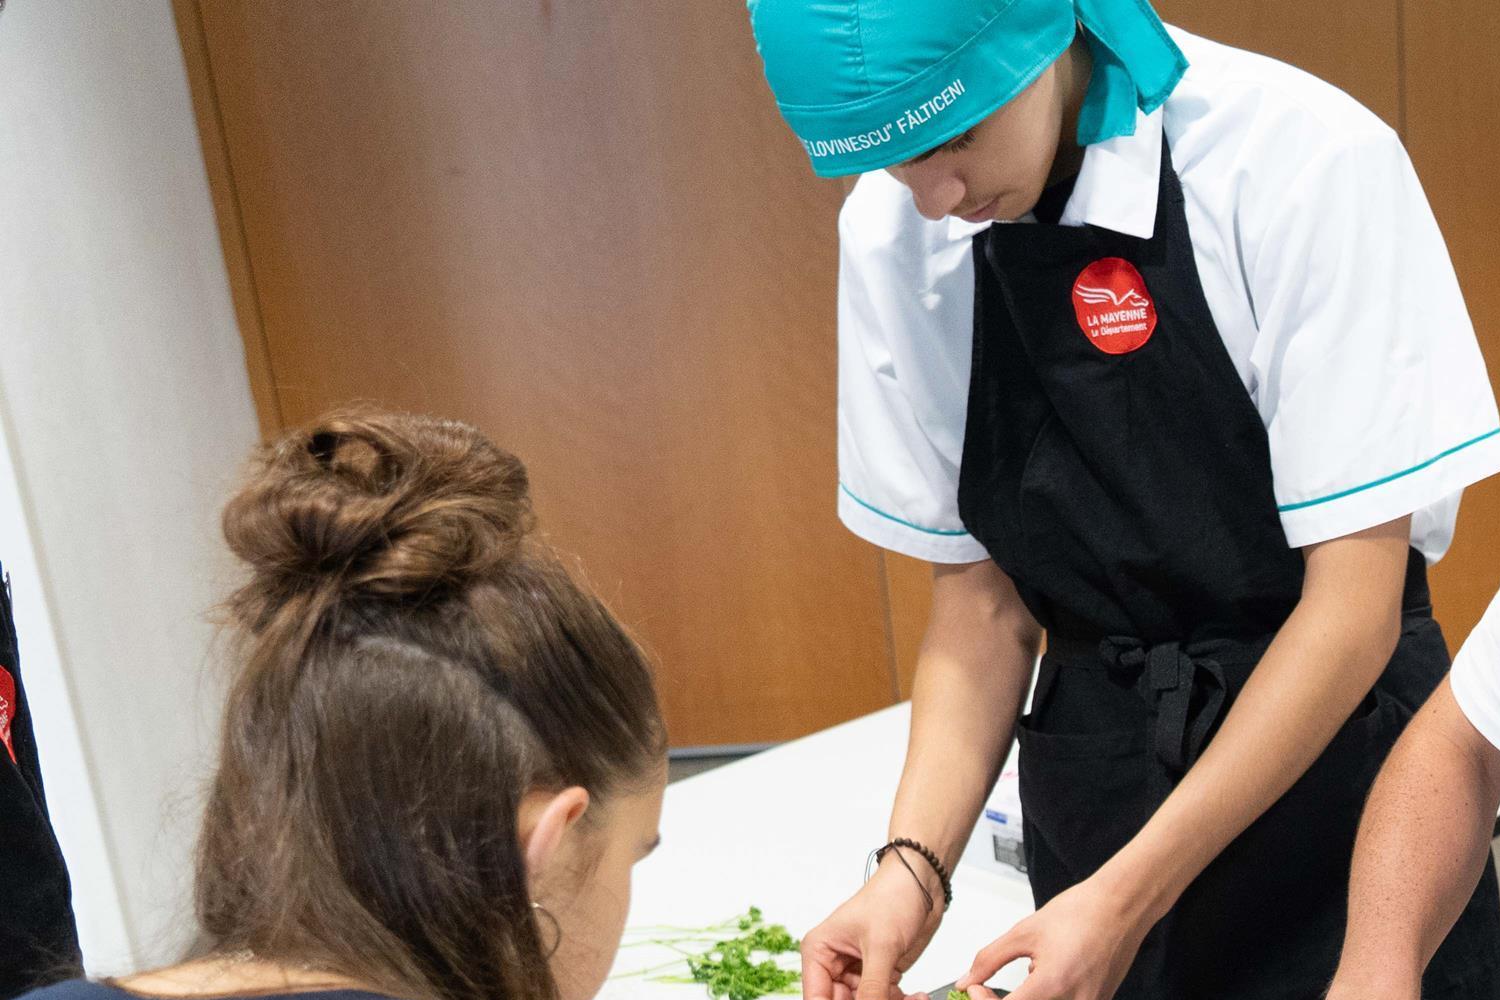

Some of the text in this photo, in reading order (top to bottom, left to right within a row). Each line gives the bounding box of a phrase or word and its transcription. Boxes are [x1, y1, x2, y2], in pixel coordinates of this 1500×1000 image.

[896, 78, 966, 134] FĂLTICENI
[1086, 308, 1147, 327] LA MAYENNE
